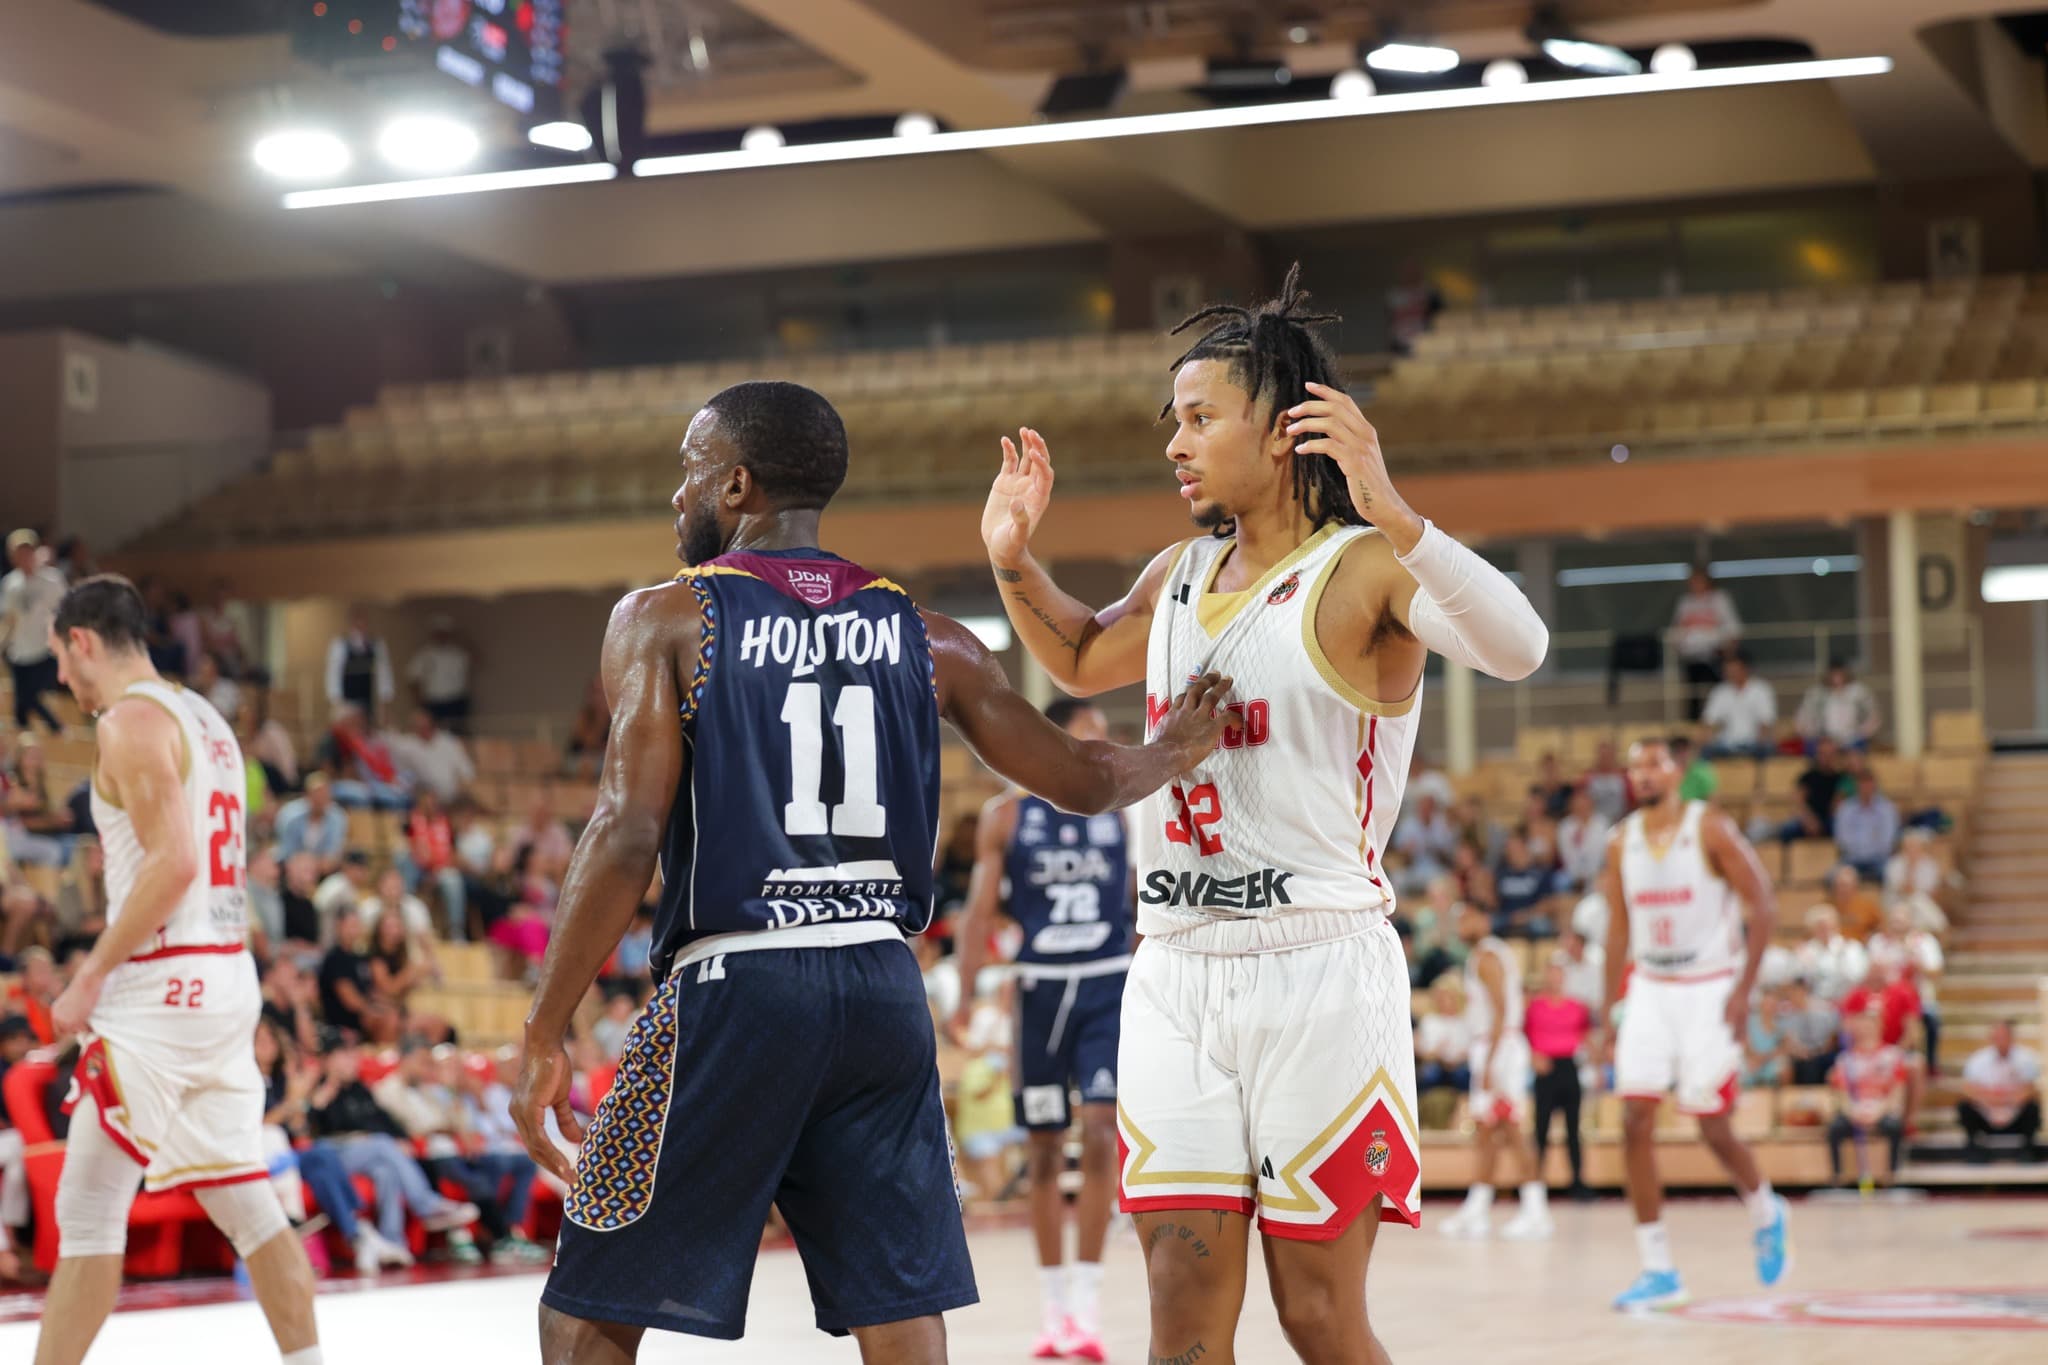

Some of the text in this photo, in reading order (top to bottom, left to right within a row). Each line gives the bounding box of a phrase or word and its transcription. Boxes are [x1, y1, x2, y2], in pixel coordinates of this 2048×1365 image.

[1918, 553, 1956, 612] D
[740, 610, 901, 678] HOLSTON
[780, 682, 886, 838] 11
[761, 882, 902, 898] FROMAGERIE
[1139, 868, 1296, 910] SNEEK
[164, 977, 204, 1009] 22
